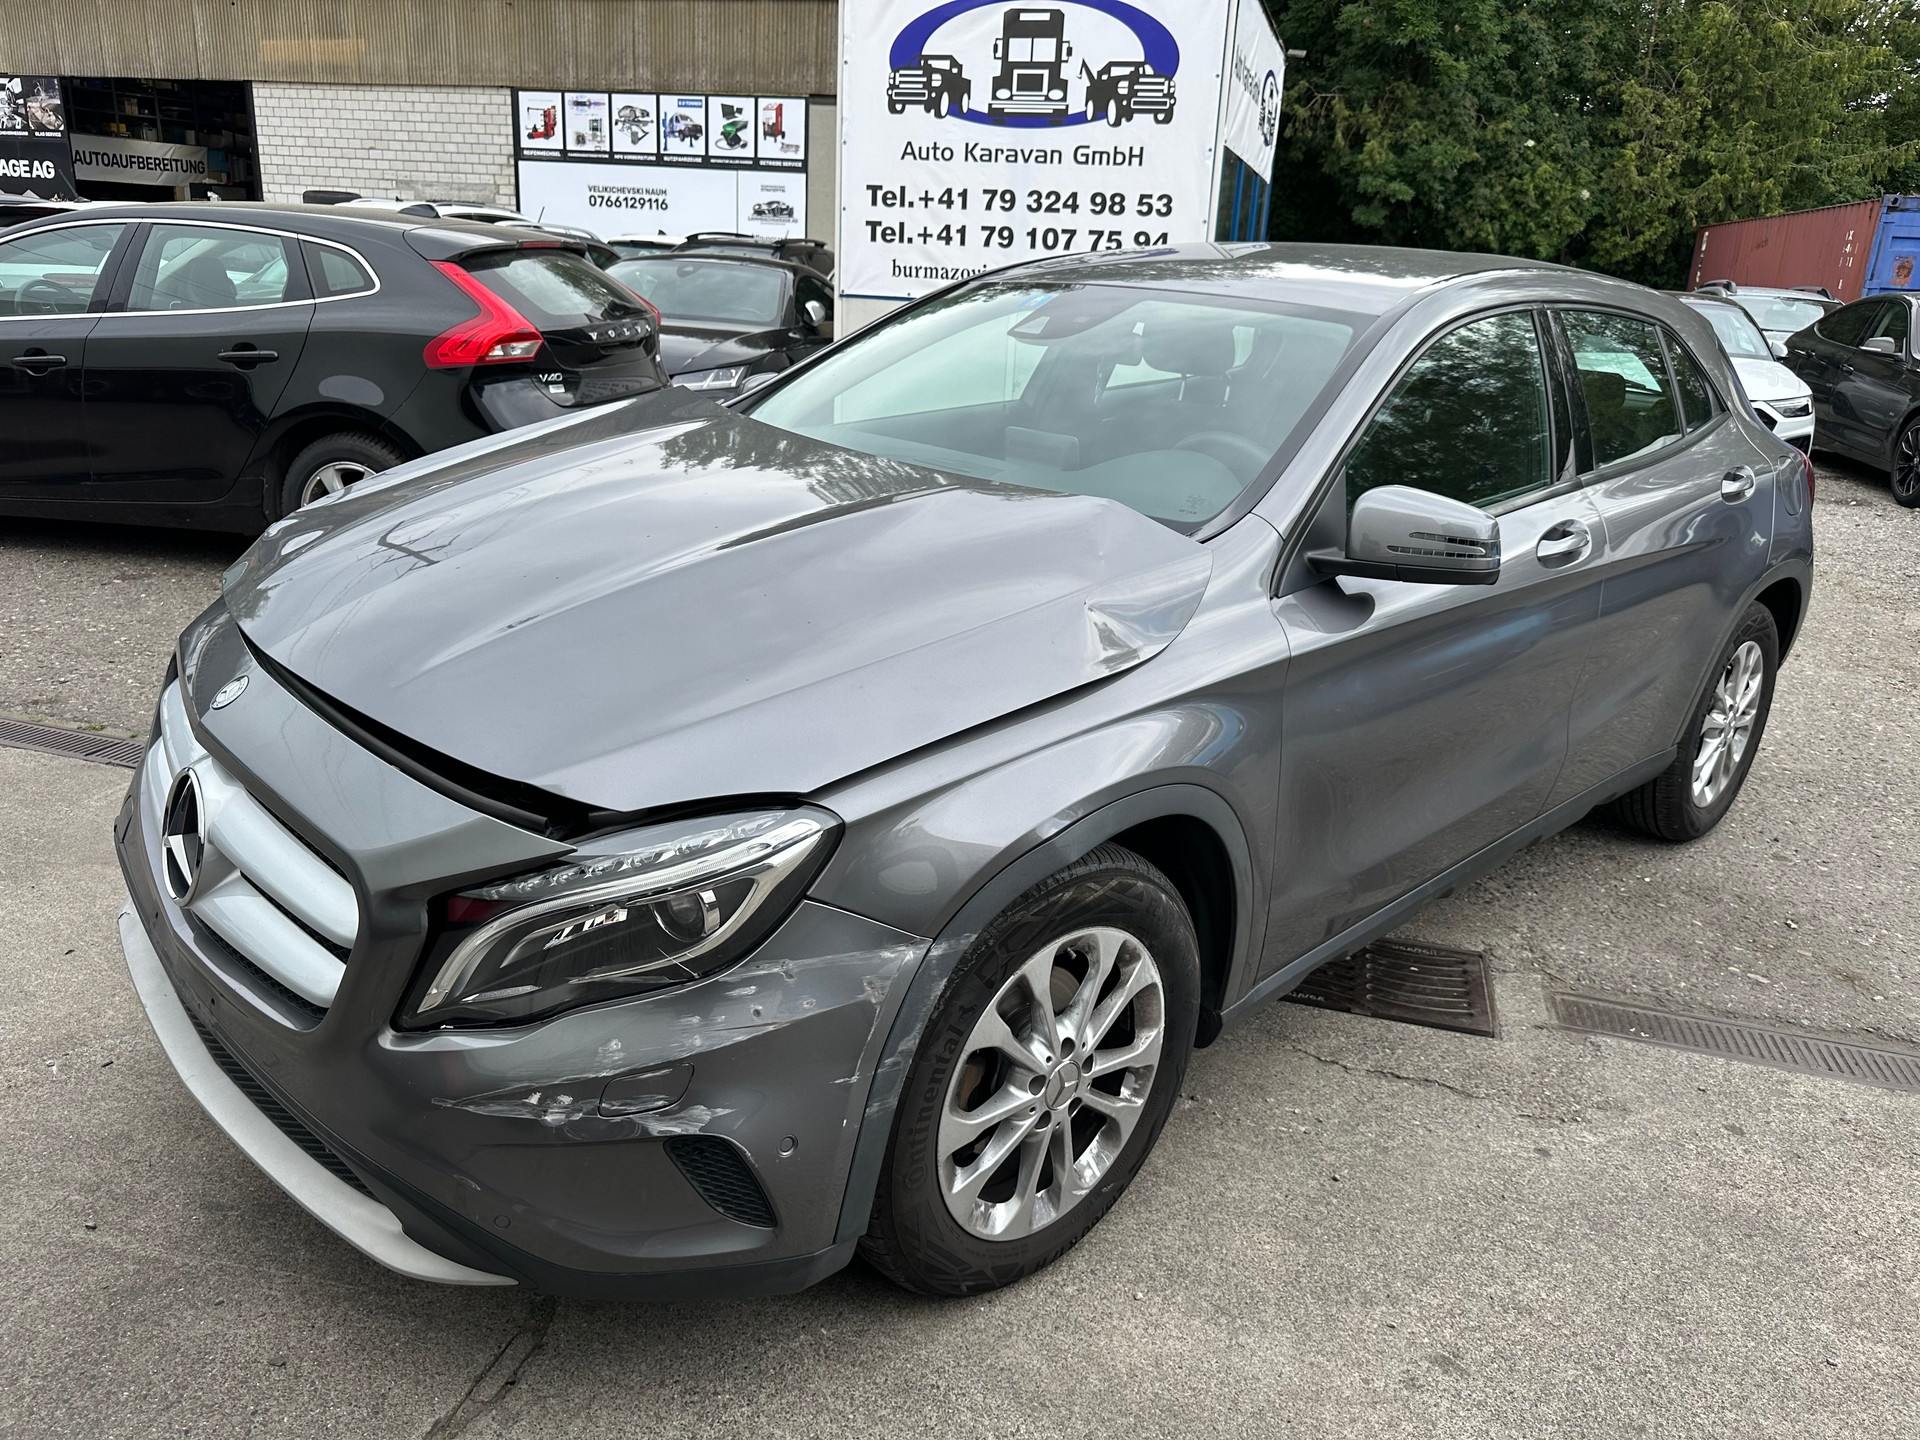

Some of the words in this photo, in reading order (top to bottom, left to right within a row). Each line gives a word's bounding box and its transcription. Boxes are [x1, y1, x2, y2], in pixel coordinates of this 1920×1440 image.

[73, 149, 206, 175] AUTOAUFBEREITUNG
[900, 141, 955, 162] Auto
[964, 142, 1063, 165] Karavan
[1072, 145, 1145, 167] GmbH
[32, 160, 55, 179] AG
[782, 160, 802, 168] SERVICE
[588, 185, 644, 195] VELIKICHEVSKI
[645, 187, 667, 196] NAUM
[589, 194, 669, 211] 0766129116
[866, 184, 969, 210] Tel.+41
[982, 188, 1017, 212] 79
[1026, 190, 1080, 214] 324
[1089, 192, 1126, 216] 98
[1136, 193, 1173, 217] 53
[865, 220, 967, 247] Tel.+41
[980, 225, 1015, 249] 79
[1026, 227, 1078, 251] 107
[1088, 230, 1123, 252] 75
[1133, 231, 1169, 247] 94
[588, 324, 652, 341] VOLVO
[539, 373, 563, 383] V40
[904, 1022, 966, 1190] Continental
